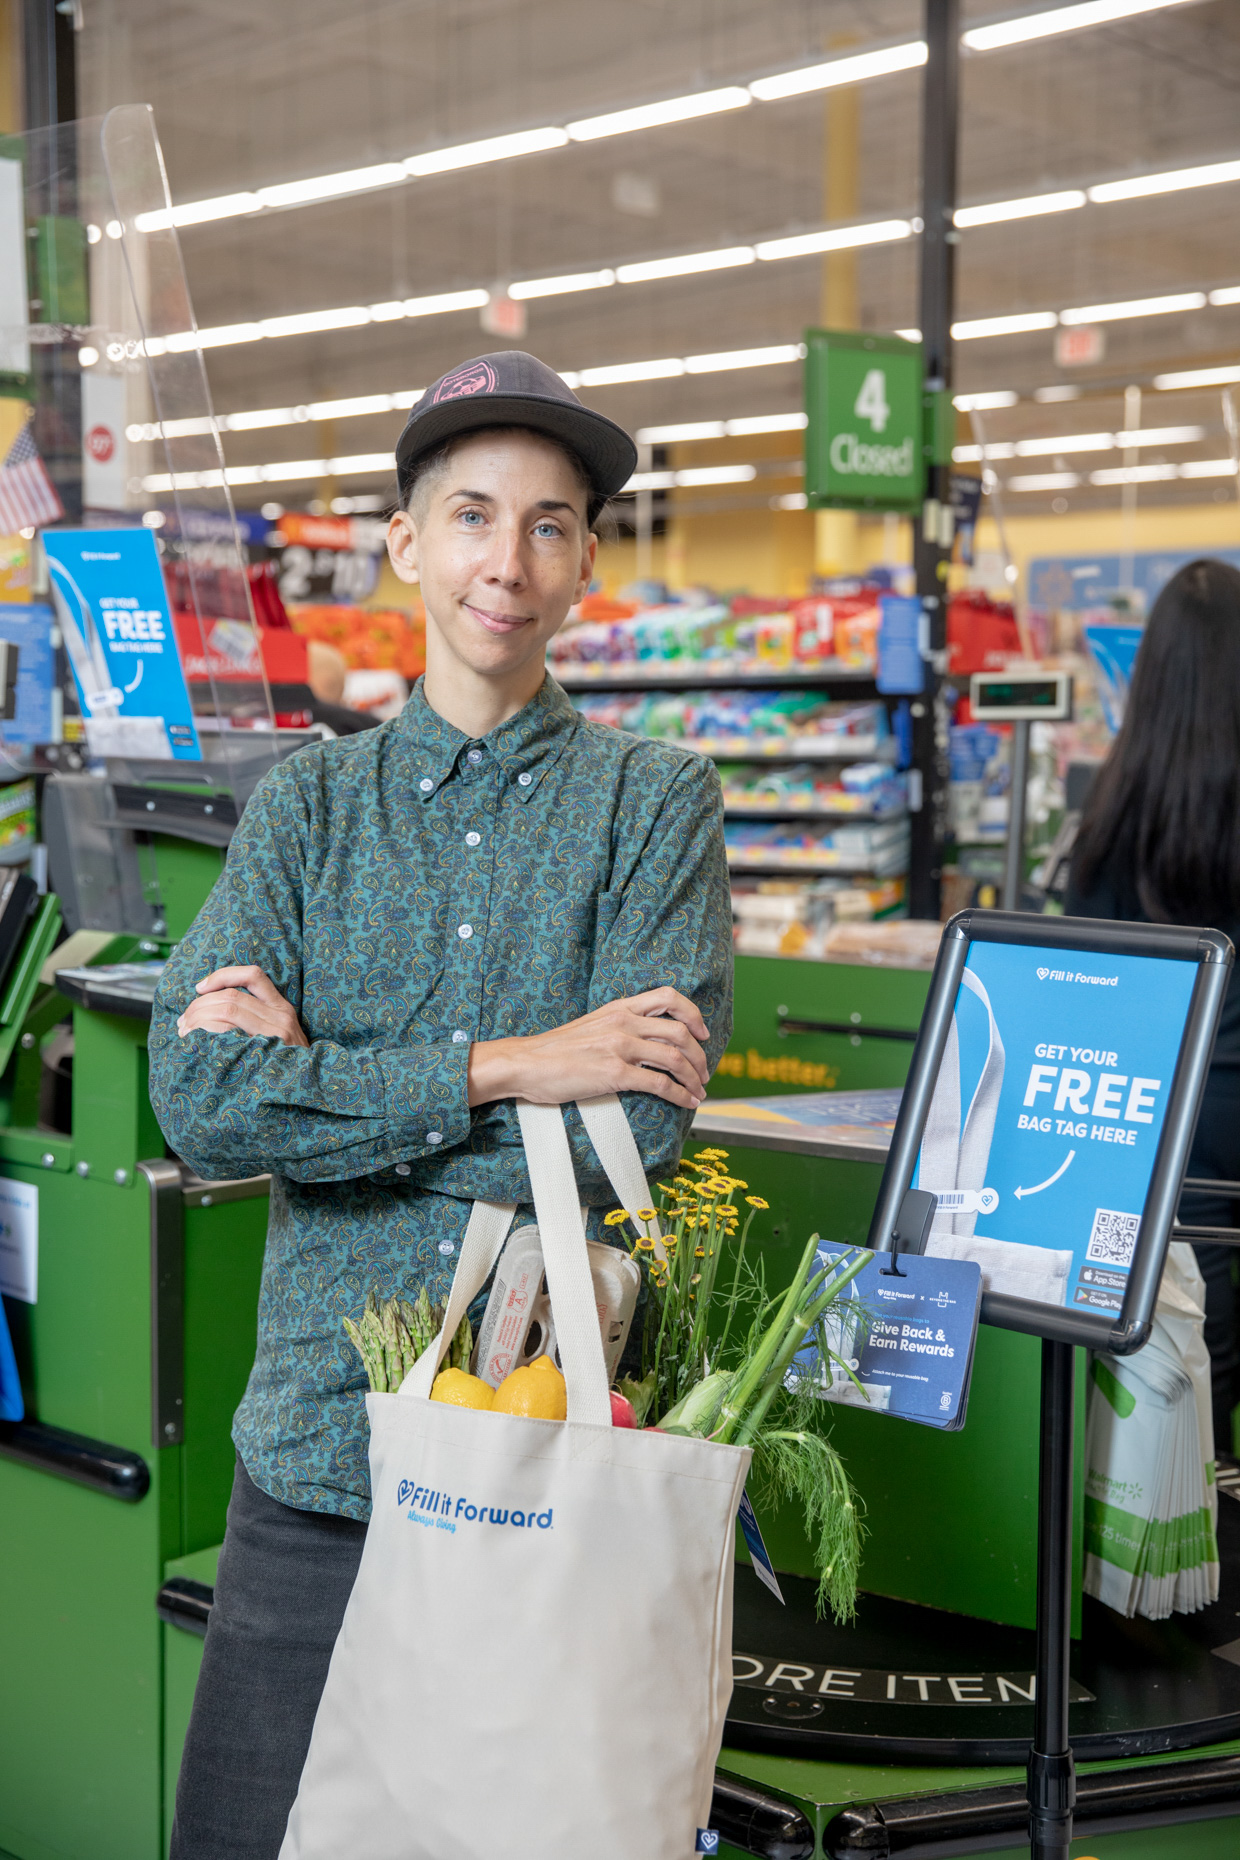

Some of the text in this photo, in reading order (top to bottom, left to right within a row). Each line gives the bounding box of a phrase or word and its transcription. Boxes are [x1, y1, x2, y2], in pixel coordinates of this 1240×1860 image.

[854, 368, 891, 433] 4
[830, 432, 914, 477] Closed
[102, 610, 166, 640] FREE
[1049, 970, 1118, 986] Fill it Forward
[1034, 1043, 1118, 1067] GET YOUR
[1023, 1063, 1161, 1124] FREE
[1017, 1114, 1138, 1146] BAG TAG HERE
[1093, 1275, 1127, 1288] App Store
[1088, 1295, 1122, 1310] Google Play
[871, 1320, 946, 1342] Give Back &
[869, 1334, 955, 1358] Earn Rewards
[407, 1509, 457, 1535] Always Giving
[410, 1486, 554, 1530] Fill it Forward
[732, 1655, 862, 1697] ORE
